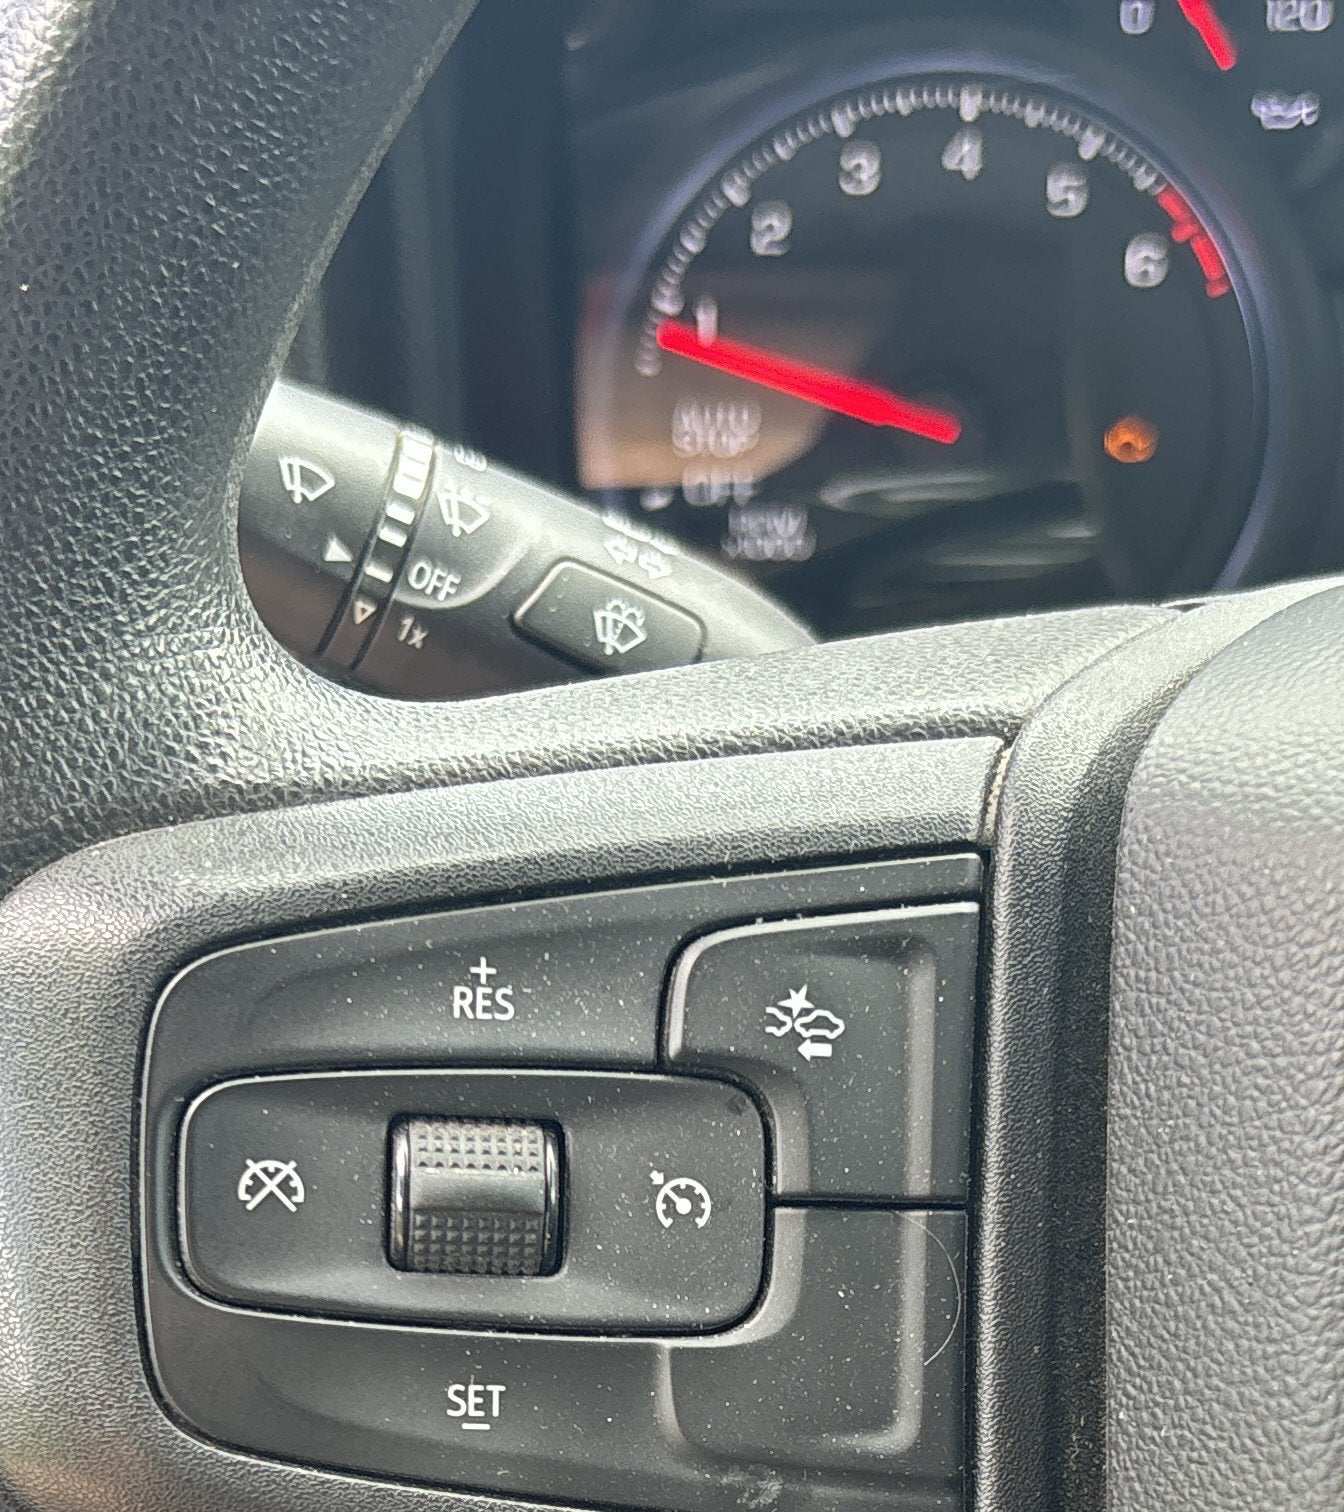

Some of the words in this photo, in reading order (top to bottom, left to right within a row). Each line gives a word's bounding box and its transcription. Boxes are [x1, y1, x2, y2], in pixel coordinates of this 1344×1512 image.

[838, 139, 882, 196] 3
[942, 128, 984, 180] 4
[1045, 163, 1089, 218] 5
[750, 200, 793, 256] 2
[1124, 232, 1169, 288] 6
[407, 559, 461, 600] OFF
[453, 986, 515, 1022] RES
[447, 1386, 505, 1418] SET
